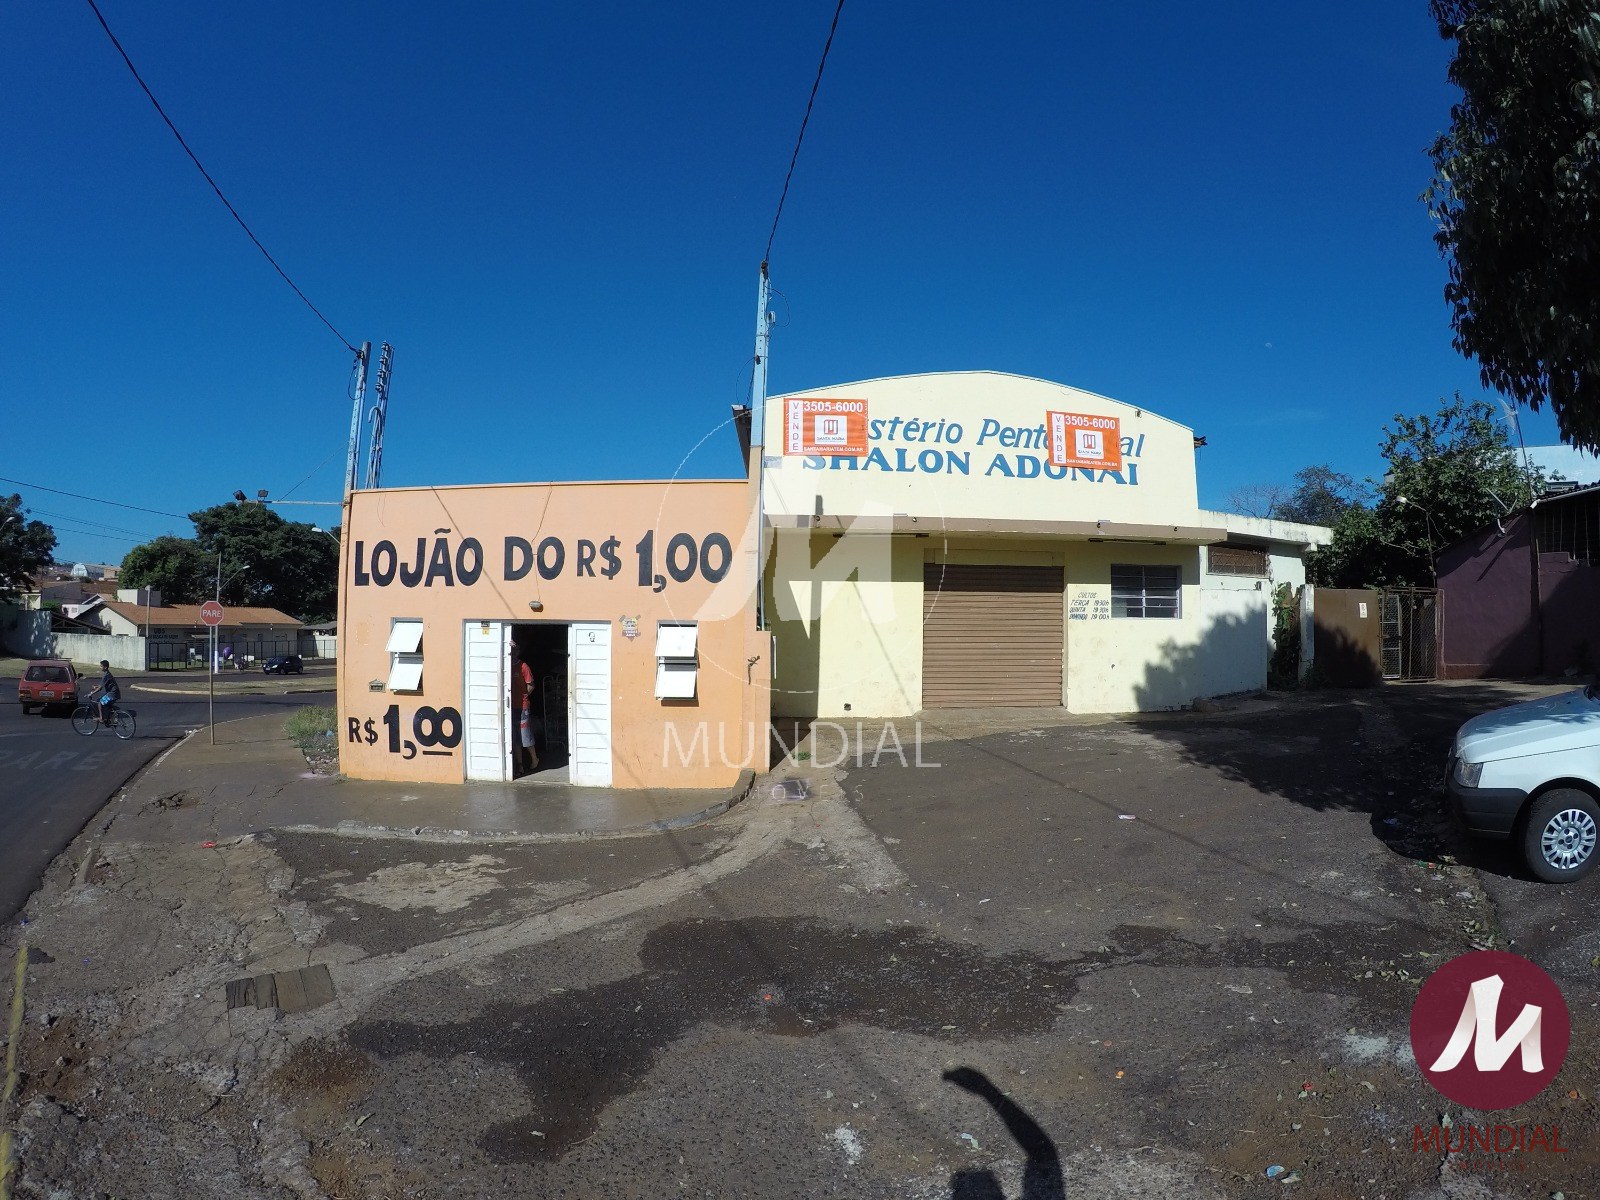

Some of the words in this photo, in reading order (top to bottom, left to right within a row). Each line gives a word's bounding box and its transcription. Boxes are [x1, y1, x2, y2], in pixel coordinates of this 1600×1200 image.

[803, 401, 863, 412] 3505-6000
[1065, 415, 1116, 430] 3505-6000
[792, 402, 800, 451] VENDE
[868, 416, 963, 444] stério
[1055, 415, 1063, 462] VENDE
[354, 527, 484, 588] LOJÃO
[503, 536, 566, 581] DO
[577, 535, 622, 580] R$
[636, 529, 733, 593] 1,00
[202, 609, 222, 618] PARE
[348, 717, 378, 746] R$
[383, 704, 462, 760] 1,00
